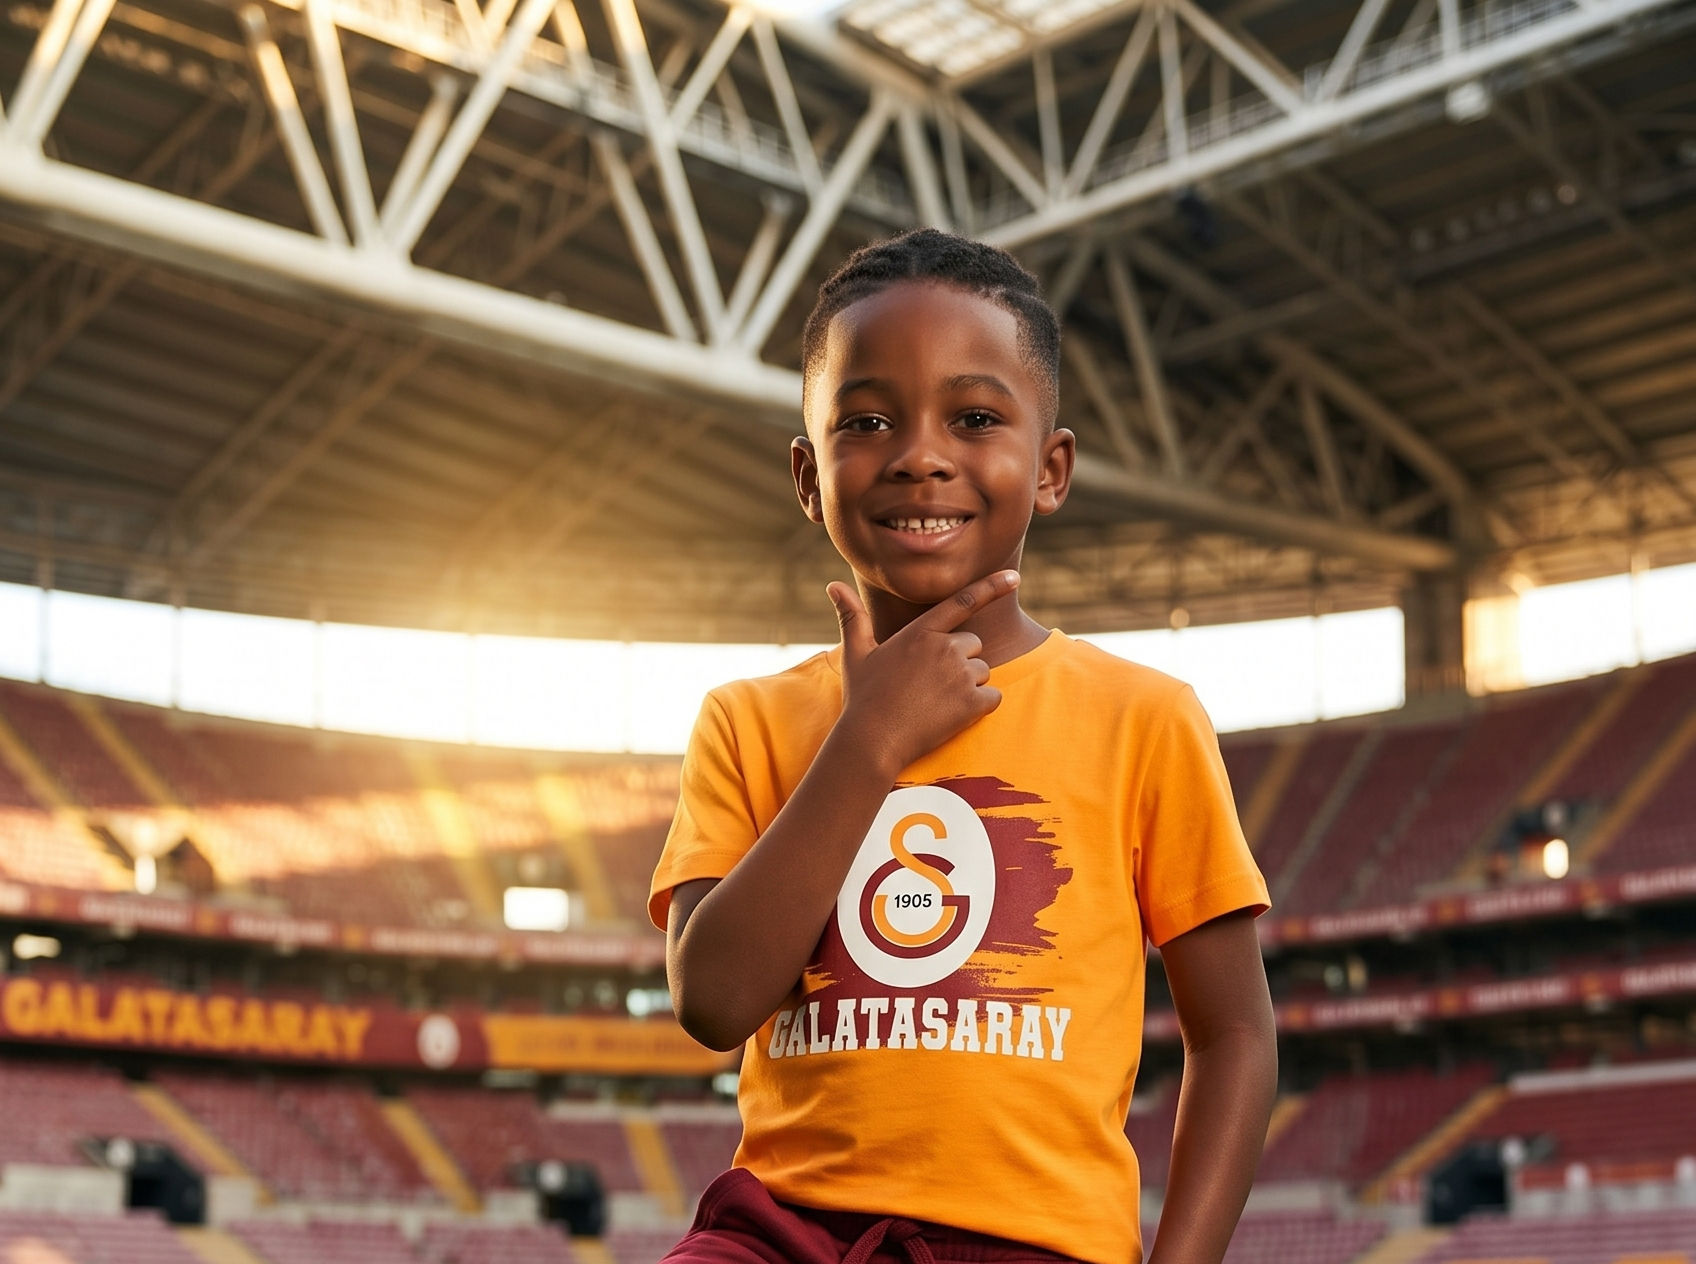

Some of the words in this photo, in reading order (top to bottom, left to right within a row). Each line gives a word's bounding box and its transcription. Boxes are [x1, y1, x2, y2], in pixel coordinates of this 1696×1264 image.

[894, 893, 932, 908] 1905
[3, 978, 371, 1058] GALATASARAY
[768, 997, 1071, 1061] GALATASARAY
